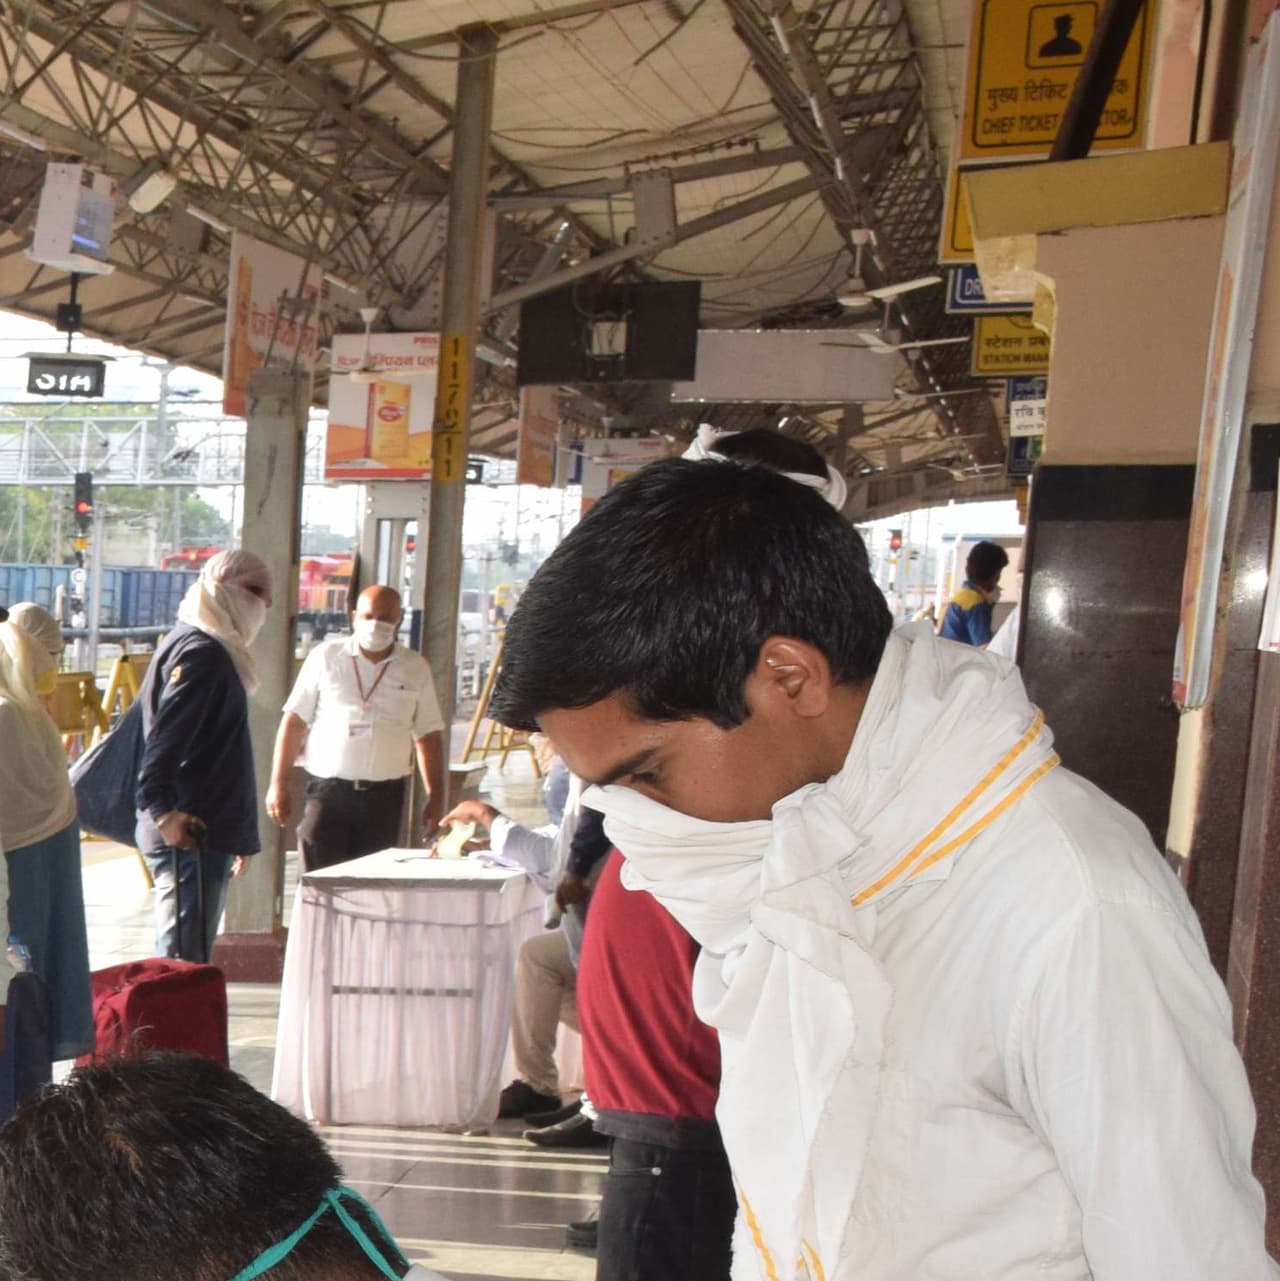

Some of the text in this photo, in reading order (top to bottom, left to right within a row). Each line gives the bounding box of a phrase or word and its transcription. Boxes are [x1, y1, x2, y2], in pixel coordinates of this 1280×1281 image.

[986, 86, 1019, 113] मुख्य
[982, 115, 1016, 135] CHIEF
[1020, 112, 1059, 132] TICKET
[984, 353, 1021, 364] STATION
